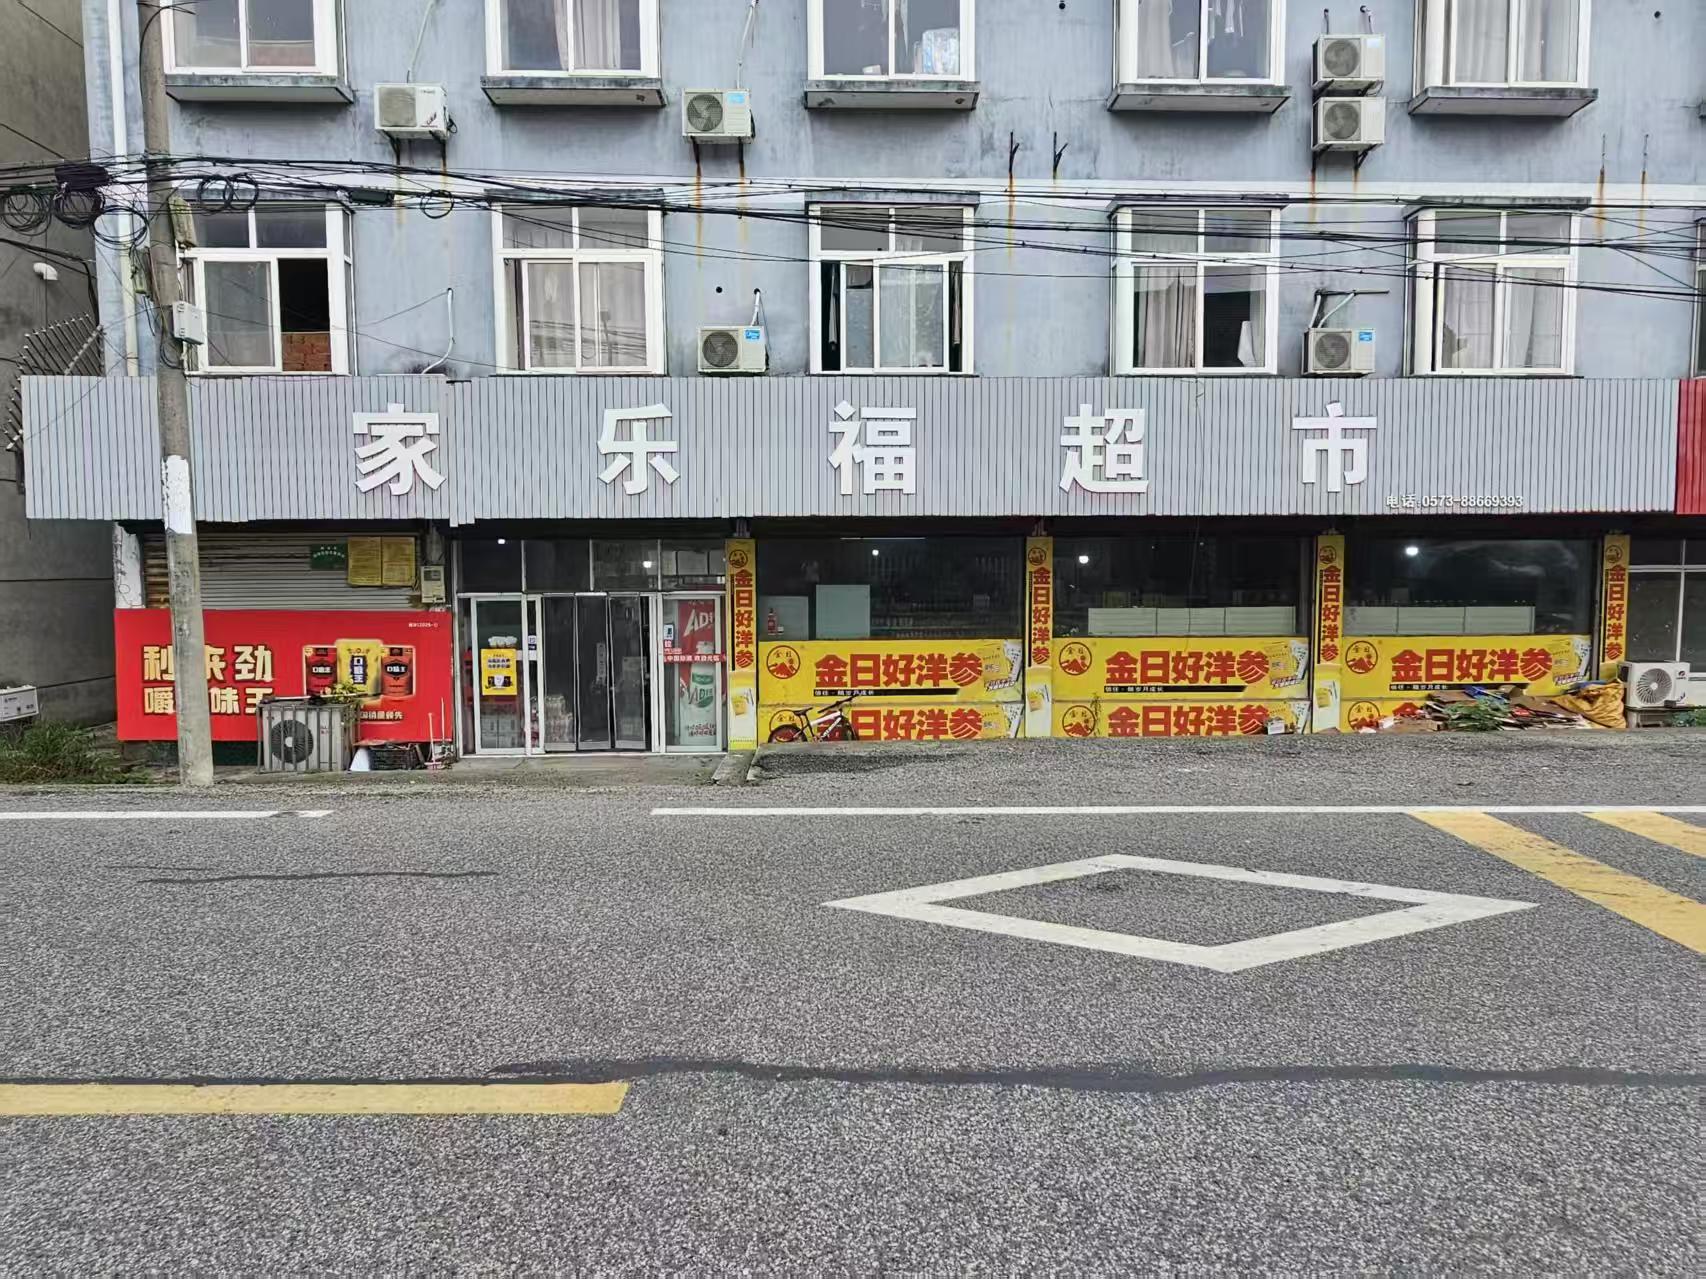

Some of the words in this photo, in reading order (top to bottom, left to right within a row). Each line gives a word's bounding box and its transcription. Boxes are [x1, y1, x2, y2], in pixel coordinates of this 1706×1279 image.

[352, 401, 1377, 496] 家乐福超市
[735, 569, 753, 668] 金日好洋参
[1033, 567, 1050, 664] 金日好洋参
[1322, 565, 1340, 661] 金日好洋参
[1606, 564, 1625, 660] 金日好洋参
[815, 653, 983, 687] 金日好洋参
[1105, 650, 1270, 684] 金日好洋参
[1391, 648, 1553, 682] 金日好洋参
[143, 687, 274, 714] 嚼味王
[1107, 704, 1270, 736] 金日好洋参
